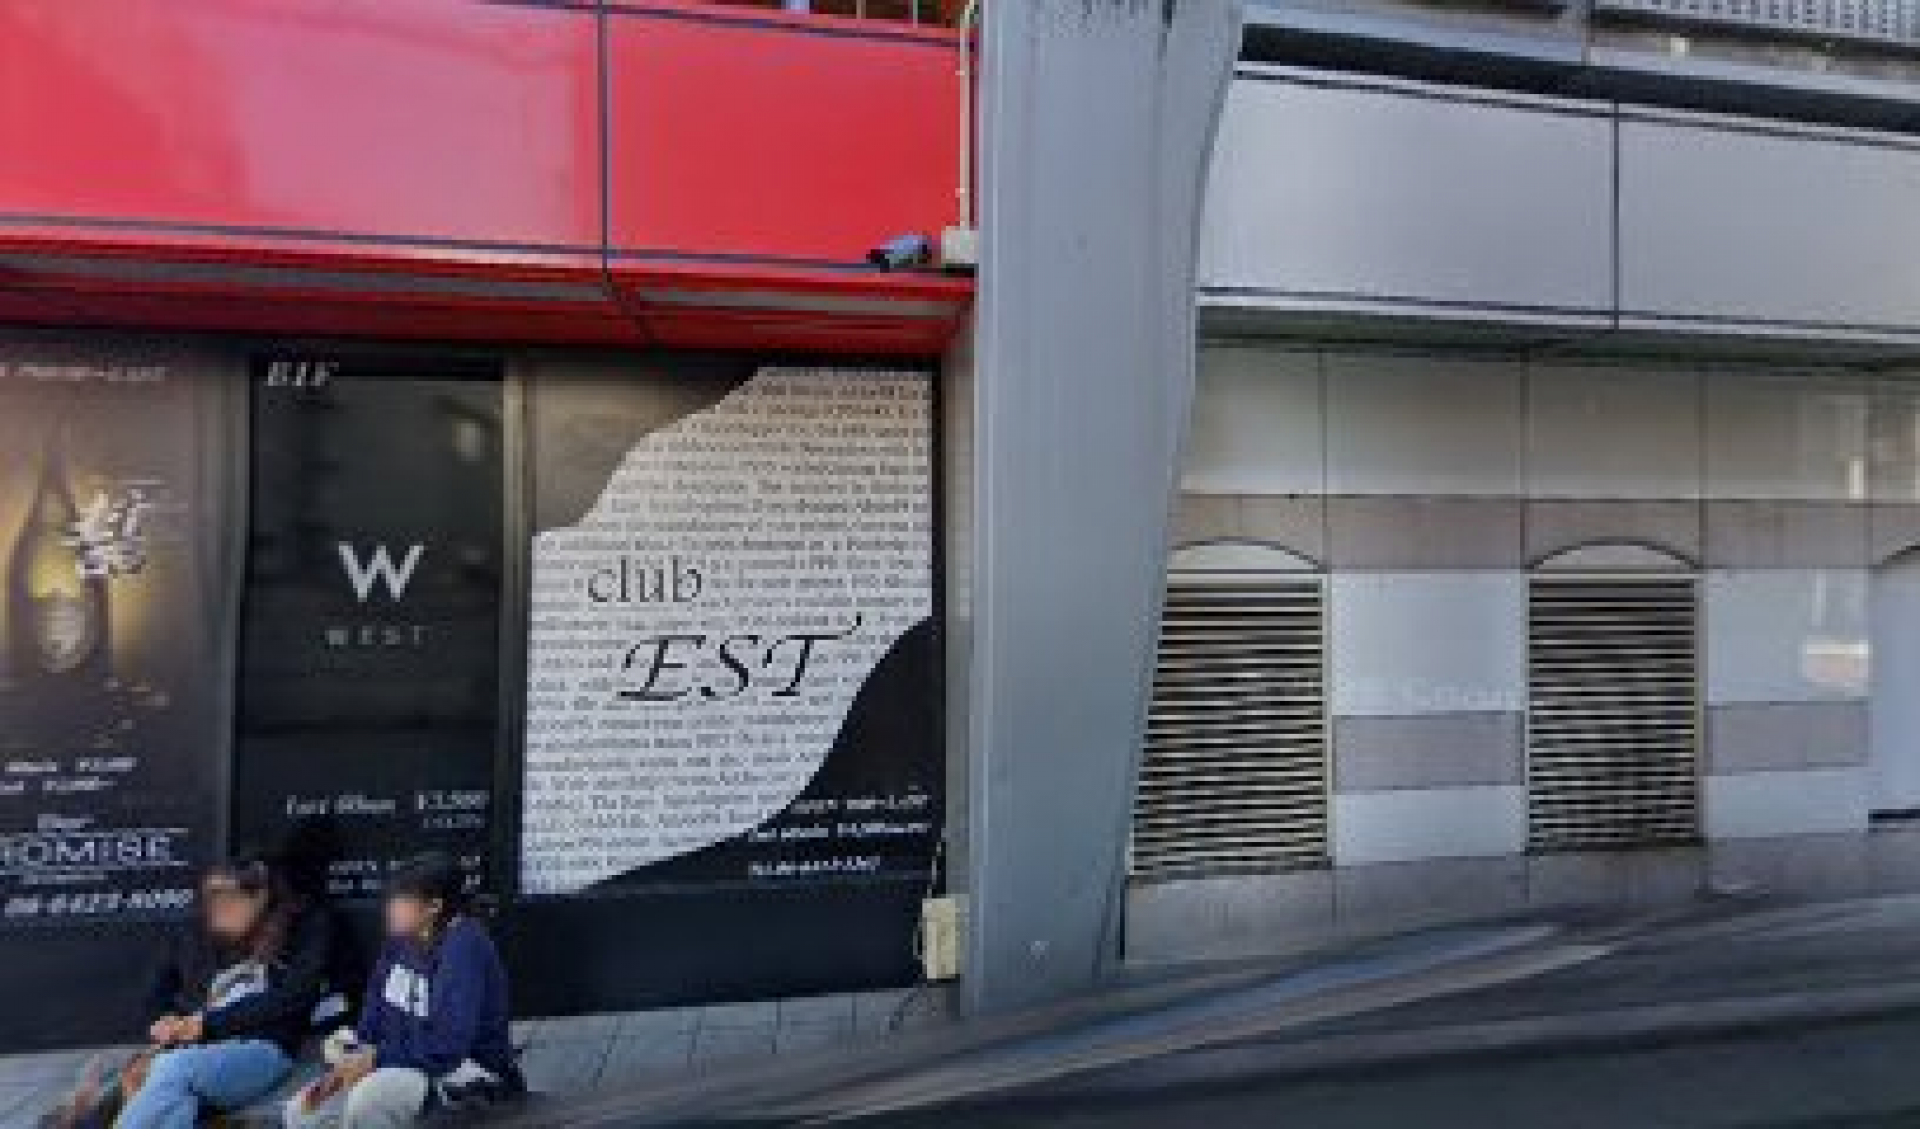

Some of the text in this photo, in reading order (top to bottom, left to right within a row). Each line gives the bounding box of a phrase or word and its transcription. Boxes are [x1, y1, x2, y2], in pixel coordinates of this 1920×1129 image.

[338, 541, 425, 600] W
[588, 555, 701, 602] club
[616, 612, 861, 701] EST
